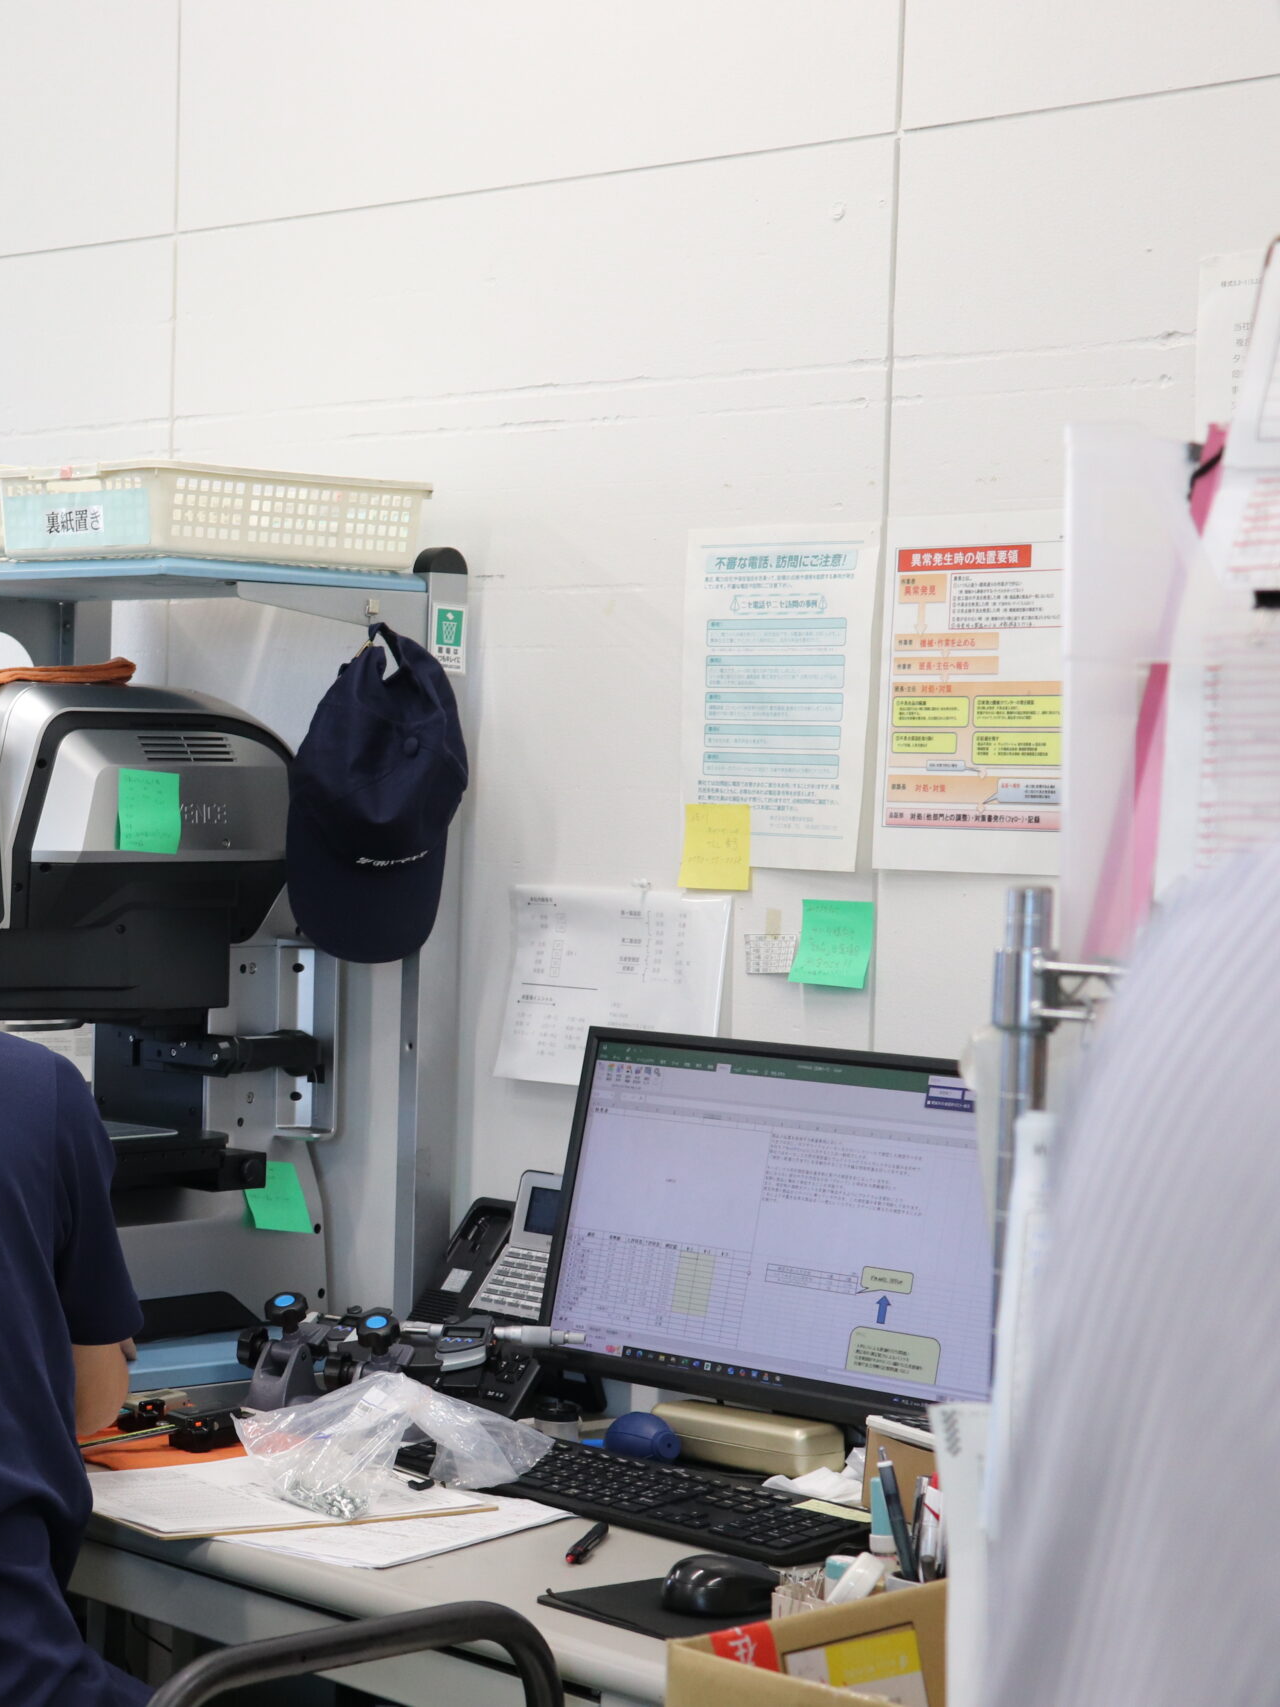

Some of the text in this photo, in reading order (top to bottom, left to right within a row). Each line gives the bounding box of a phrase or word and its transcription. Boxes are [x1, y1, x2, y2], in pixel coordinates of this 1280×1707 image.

[46, 510, 101, 535] 裏紙置き
[911, 550, 1019, 567] 異常発生時の処置要領
[904, 585, 936, 596] 異常発見
